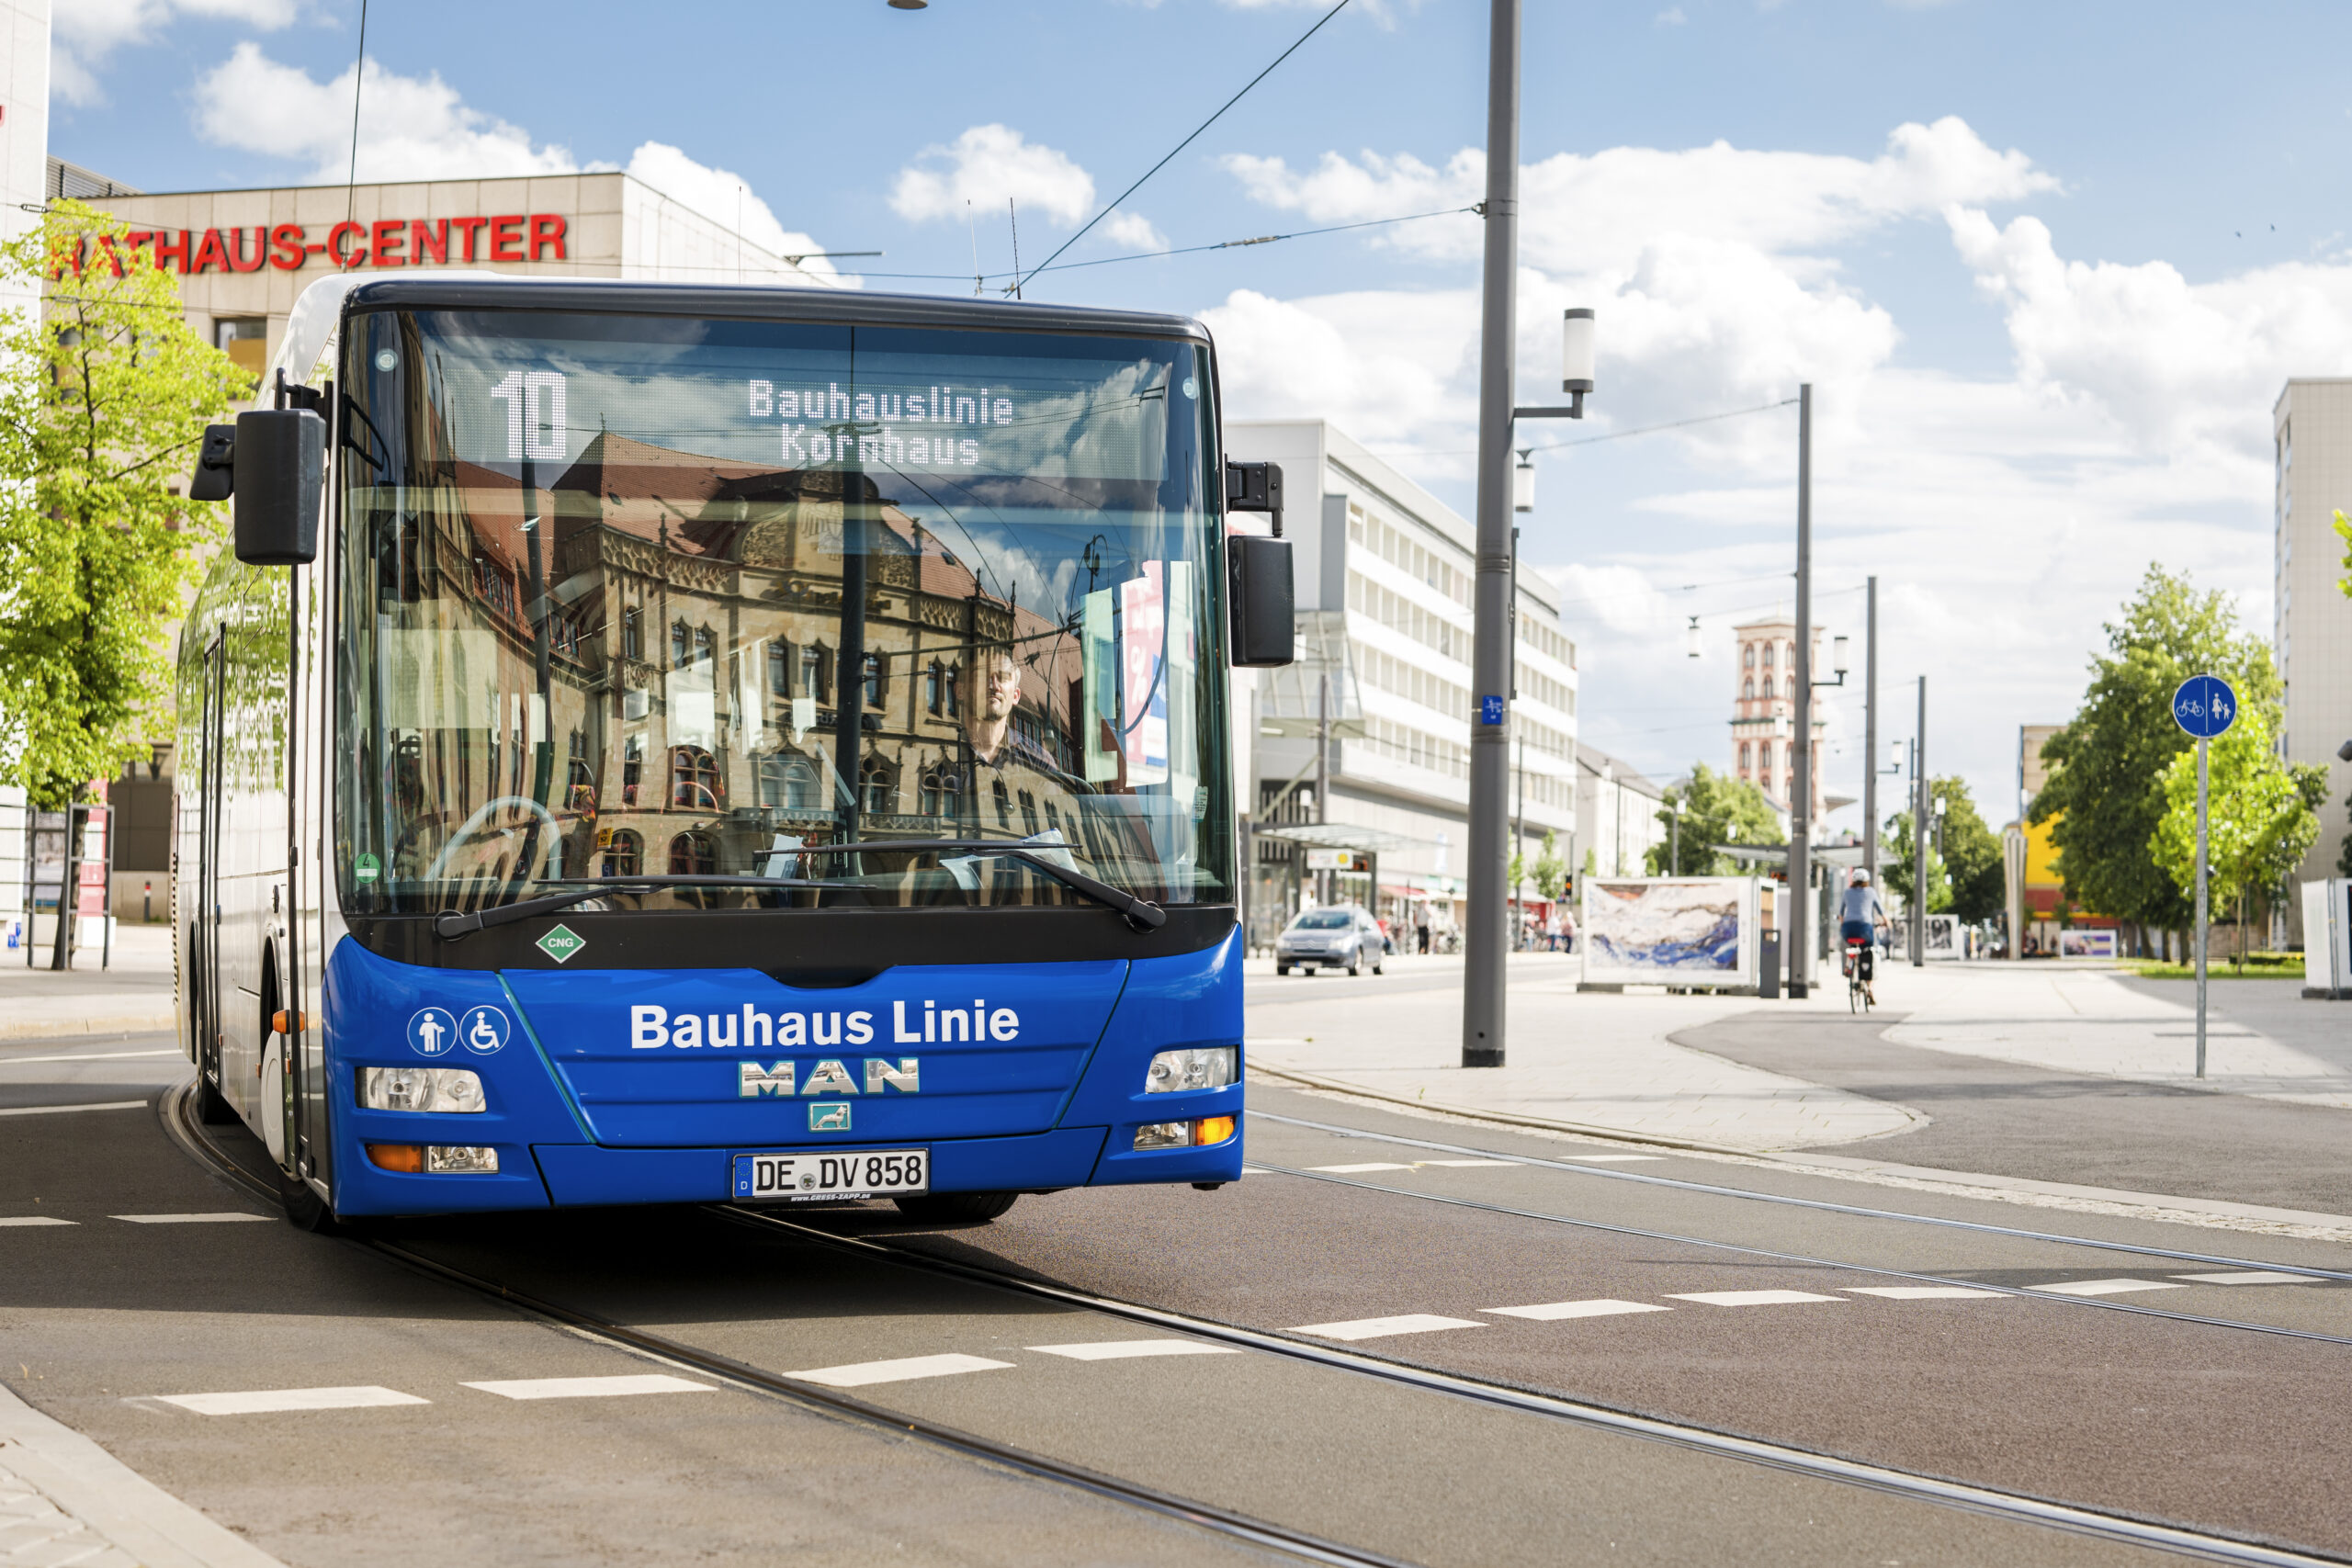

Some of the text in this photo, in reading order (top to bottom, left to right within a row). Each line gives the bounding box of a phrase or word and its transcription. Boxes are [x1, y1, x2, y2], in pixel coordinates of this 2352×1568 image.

[491, 370, 567, 459] 10
[749, 378, 1013, 425] Bauhauslinie
[781, 423, 979, 466] Kornhaus
[362, 853, 370, 868] 4
[548, 937, 574, 948] CNG
[630, 998, 1020, 1049] Bauhaus Linie
[739, 1057, 919, 1098] MAN
[740, 1180, 749, 1190] D
[756, 1156, 922, 1190] DE DV 858
